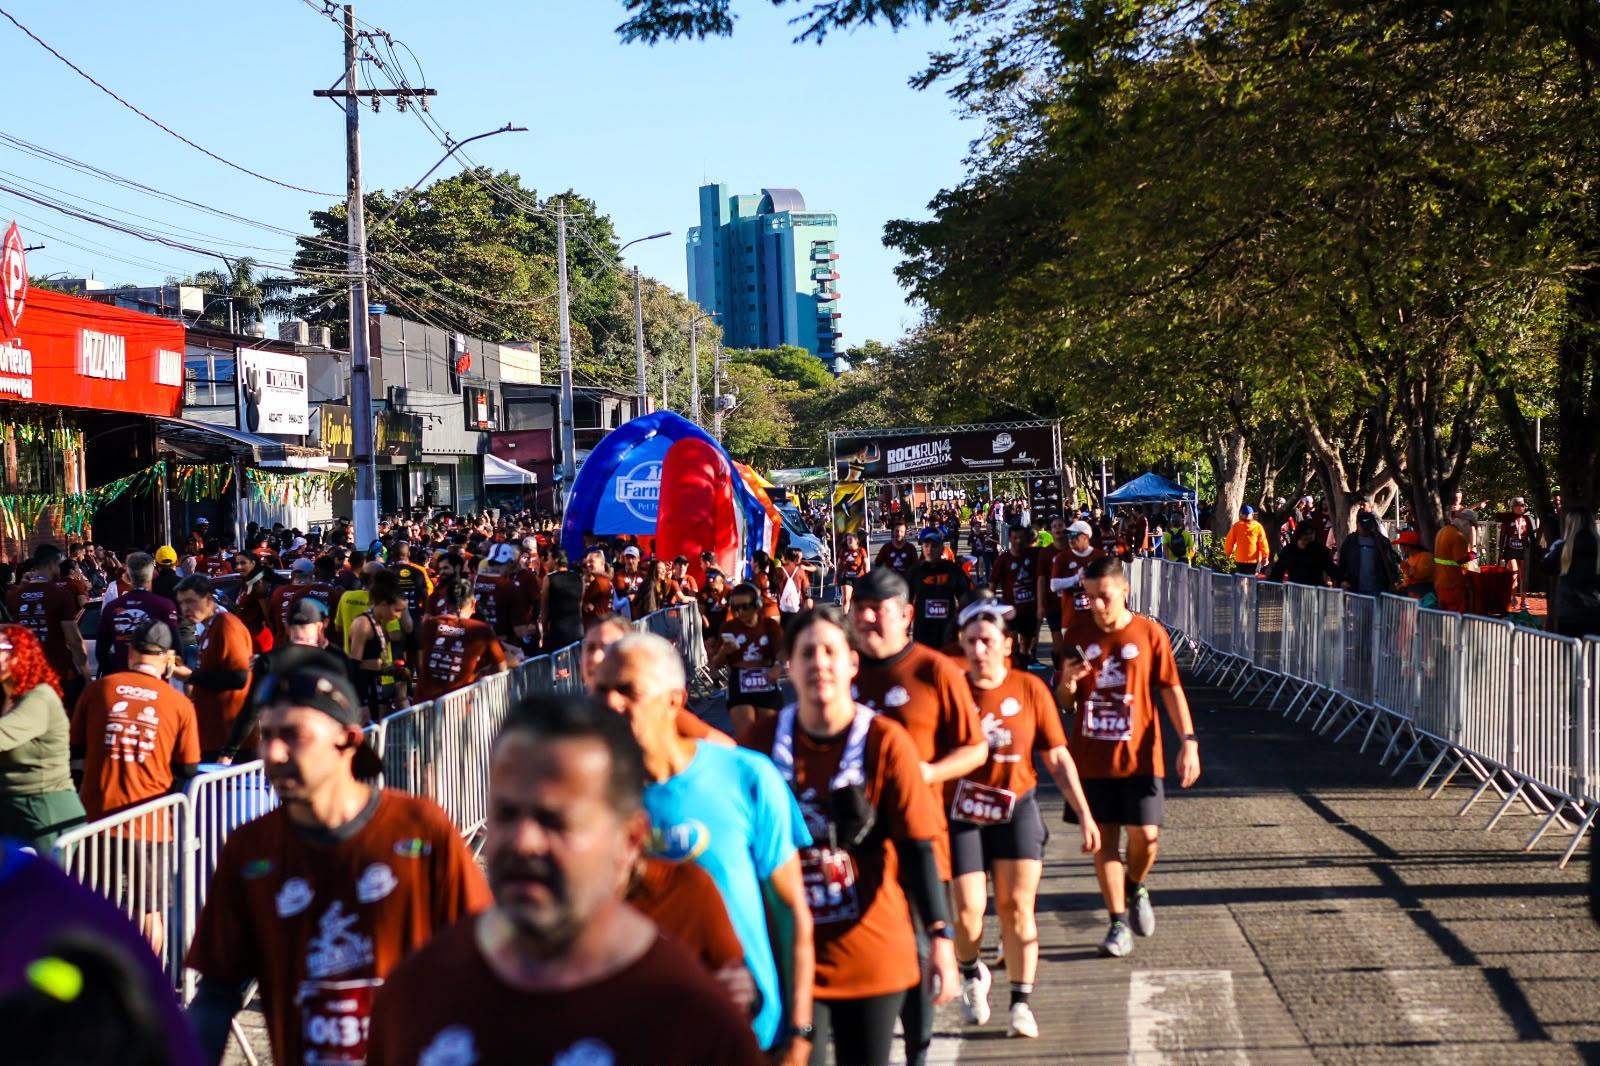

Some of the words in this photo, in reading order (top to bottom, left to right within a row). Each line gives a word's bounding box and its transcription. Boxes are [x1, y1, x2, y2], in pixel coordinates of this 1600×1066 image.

[83, 329, 126, 380] PIZZARIA
[21, 591, 44, 599] CROSS
[438, 624, 465, 635] CROSS
[116, 685, 158, 700] CROSS
